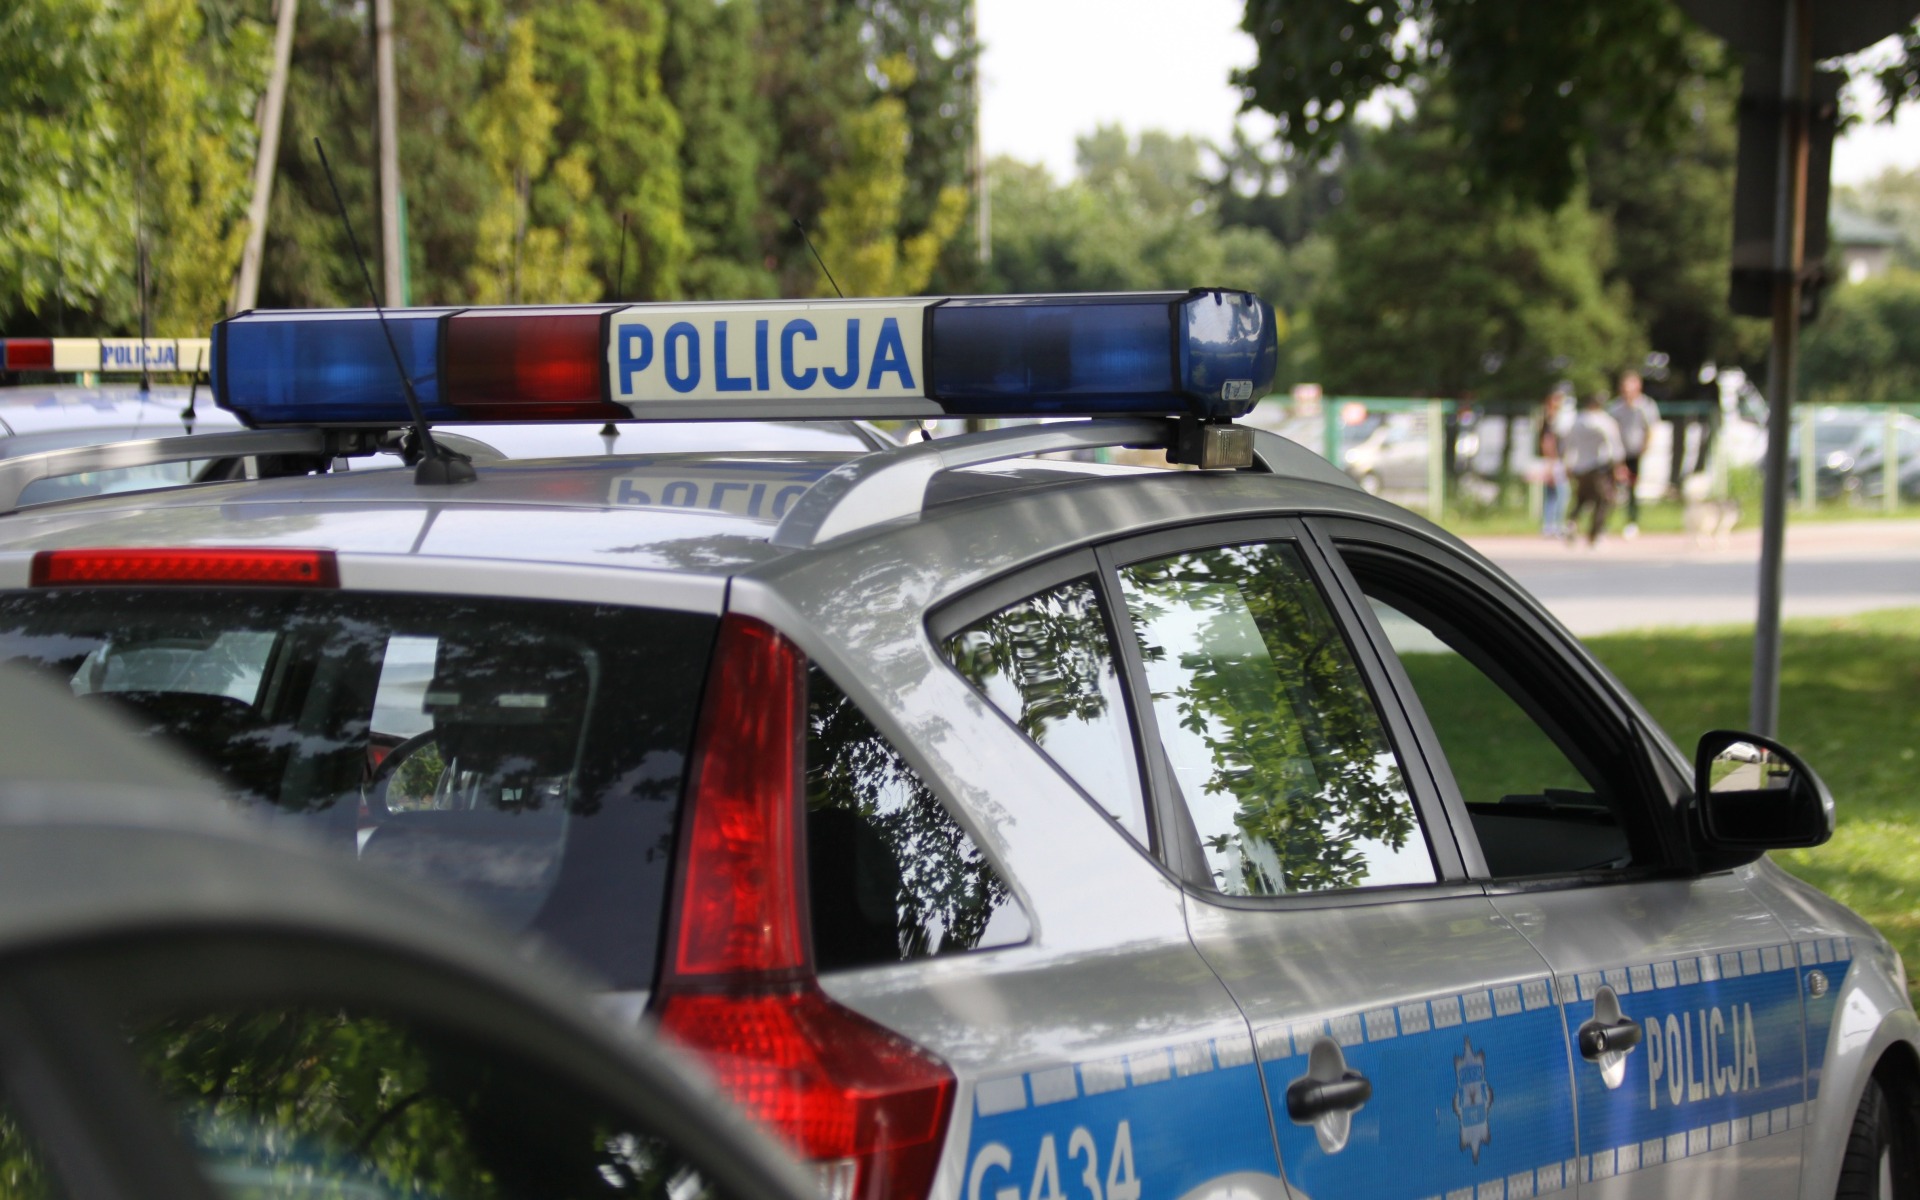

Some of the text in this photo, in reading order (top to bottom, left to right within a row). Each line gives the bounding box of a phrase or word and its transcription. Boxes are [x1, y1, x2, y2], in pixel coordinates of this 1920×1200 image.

[102, 346, 175, 364] POLICJA
[618, 317, 916, 395] POLICJA
[1645, 1002, 1760, 1110] POLICJA
[968, 1120, 1141, 1200] G434
